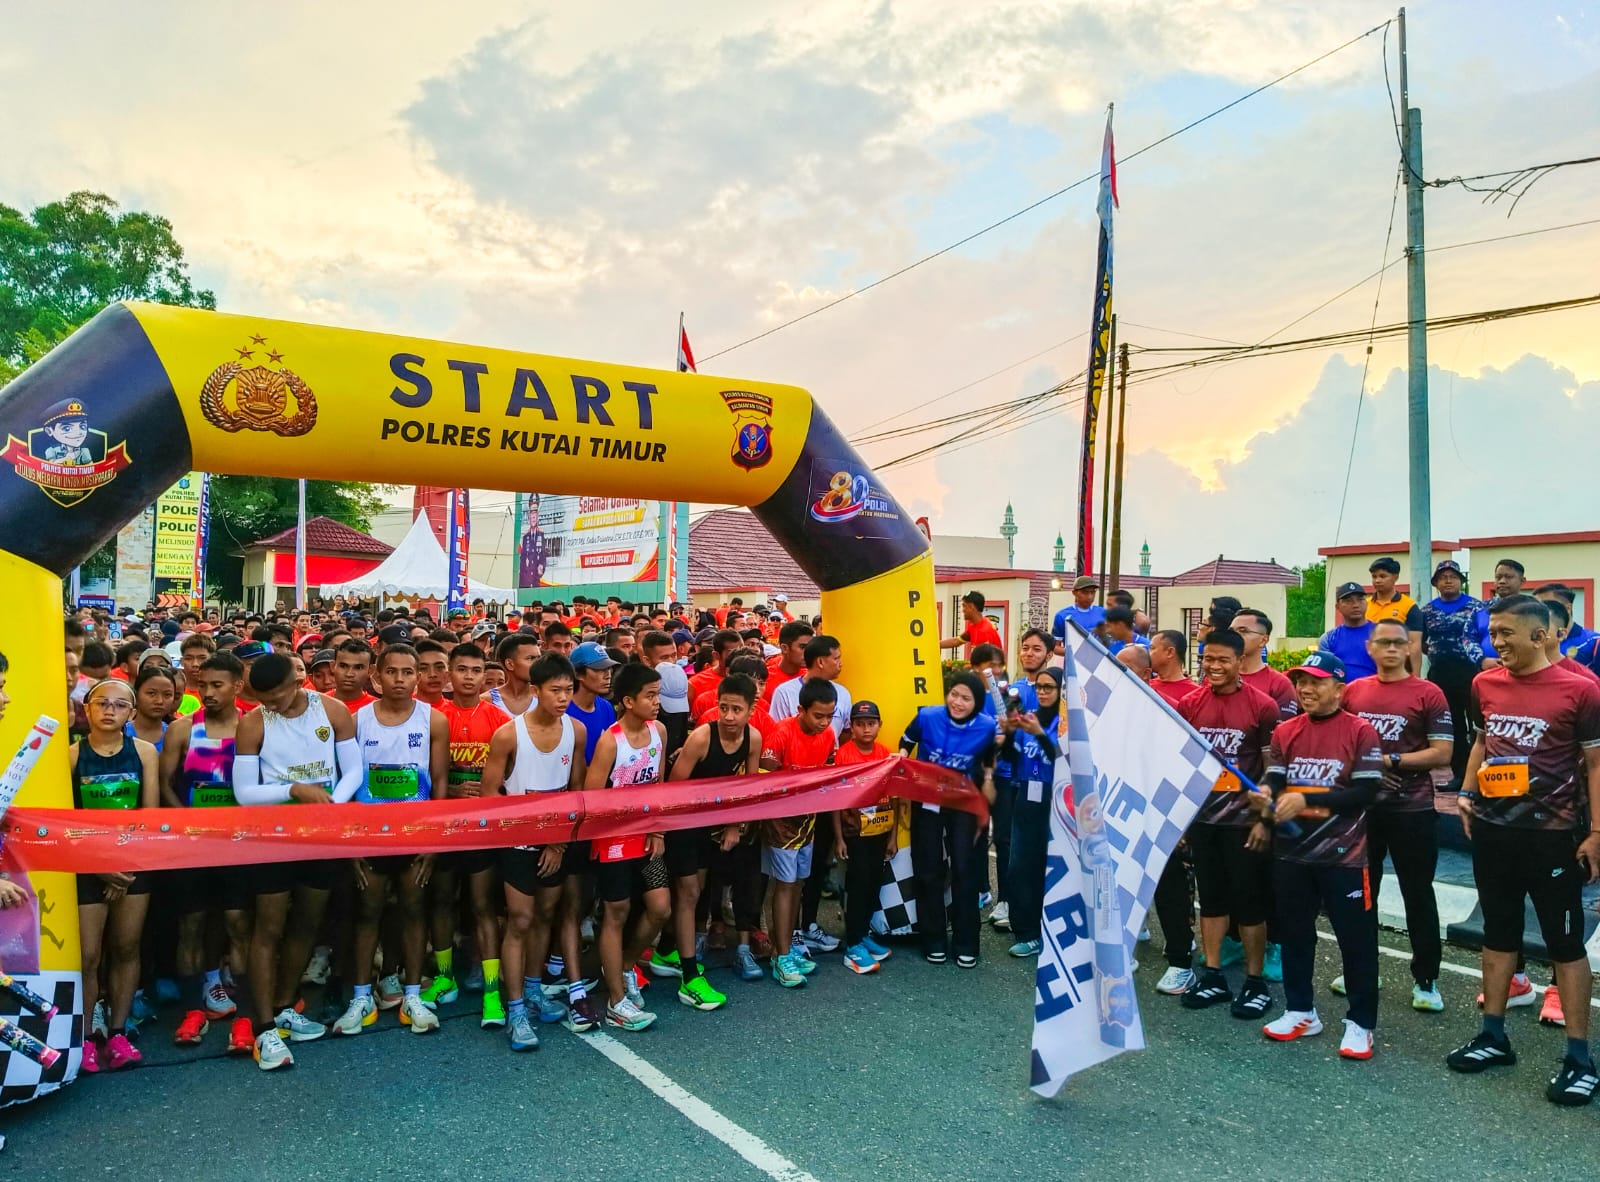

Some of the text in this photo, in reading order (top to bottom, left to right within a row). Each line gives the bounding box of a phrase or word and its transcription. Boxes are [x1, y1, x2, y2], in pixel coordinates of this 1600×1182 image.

[389, 352, 659, 430] START
[381, 418, 668, 464] POLRES KUTAI TIMUR
[41, 463, 61, 474] POLRES
[162, 505, 198, 516] POLIS
[863, 499, 888, 512] POLRI
[159, 522, 196, 532] POLIC
[908, 590, 928, 711] POLR
[1486, 721, 1526, 738] RUN
[1287, 763, 1326, 779] RUN
[1484, 772, 1516, 782] V0018
[376, 775, 410, 785] U0237
